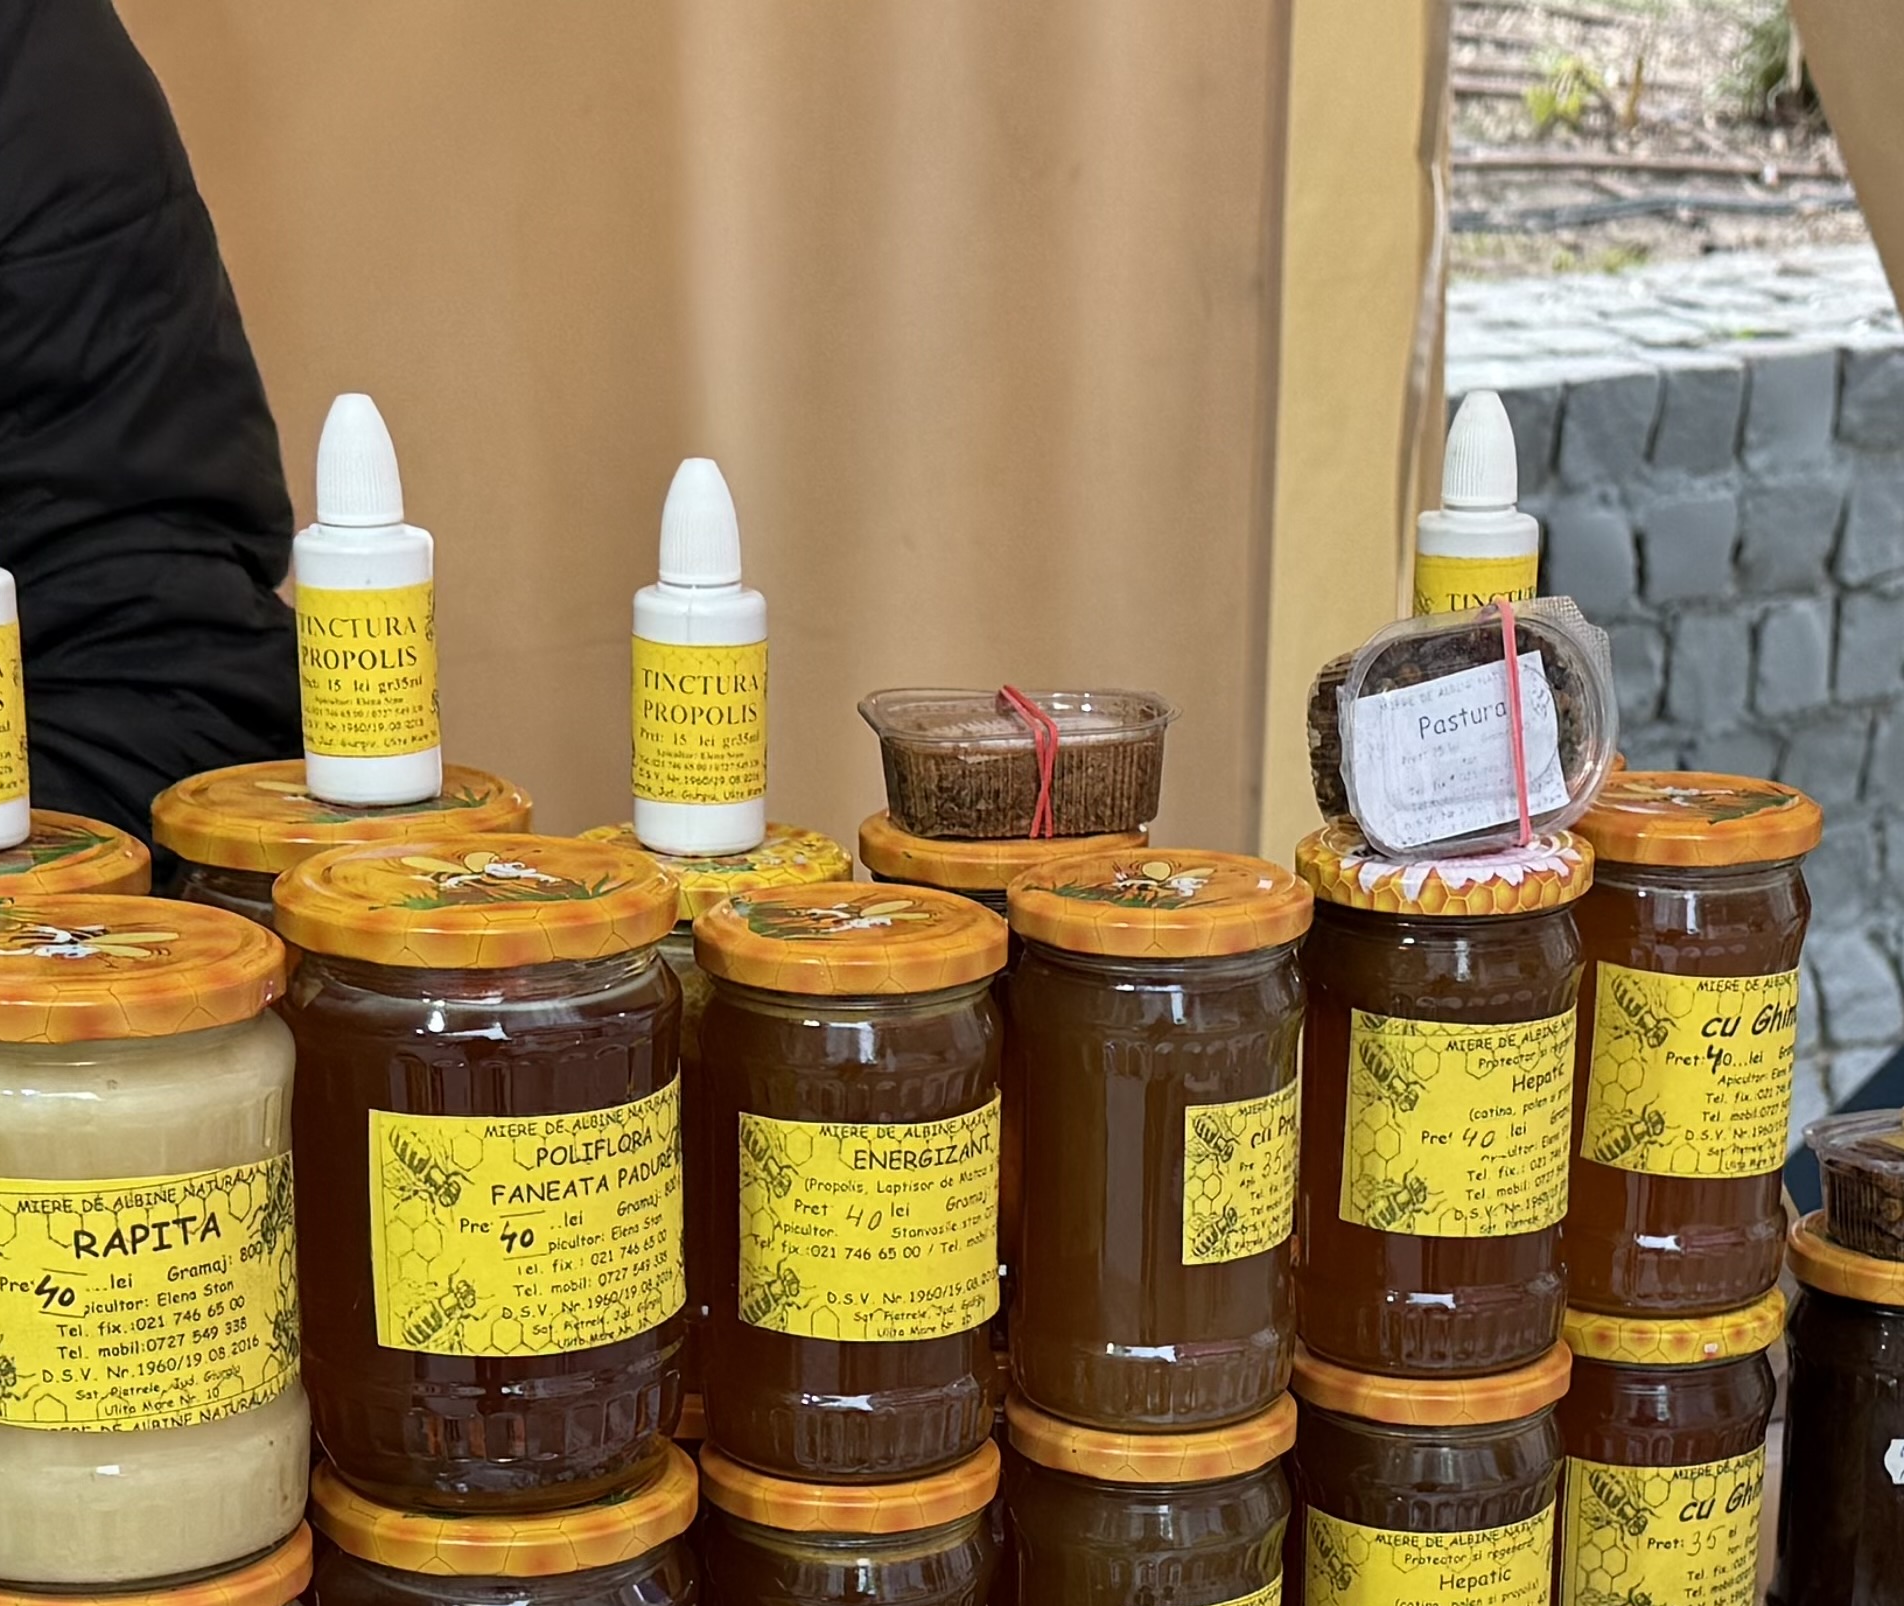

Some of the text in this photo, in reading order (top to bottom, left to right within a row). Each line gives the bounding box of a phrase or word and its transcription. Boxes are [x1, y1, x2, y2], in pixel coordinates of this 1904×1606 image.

[299, 613, 417, 638] TINCTURA
[301, 645, 417, 670] PROPOLIS
[641, 667, 759, 695] TINCTURA
[643, 700, 758, 726] PROPOLIS
[1419, 700, 1507, 740] Pastura
[1701, 1016, 1741, 1038] cu
[536, 1126, 653, 1168] POLIFLORA
[853, 1133, 991, 1170] ENERGIZANT
[491, 1174, 609, 1206] FANEATA
[73, 1212, 220, 1260] RAPITA
[1679, 1498, 1716, 1522] cu
[1404, 1553, 1467, 1565] Protector
[1439, 1568, 1512, 1593] Hepatic
